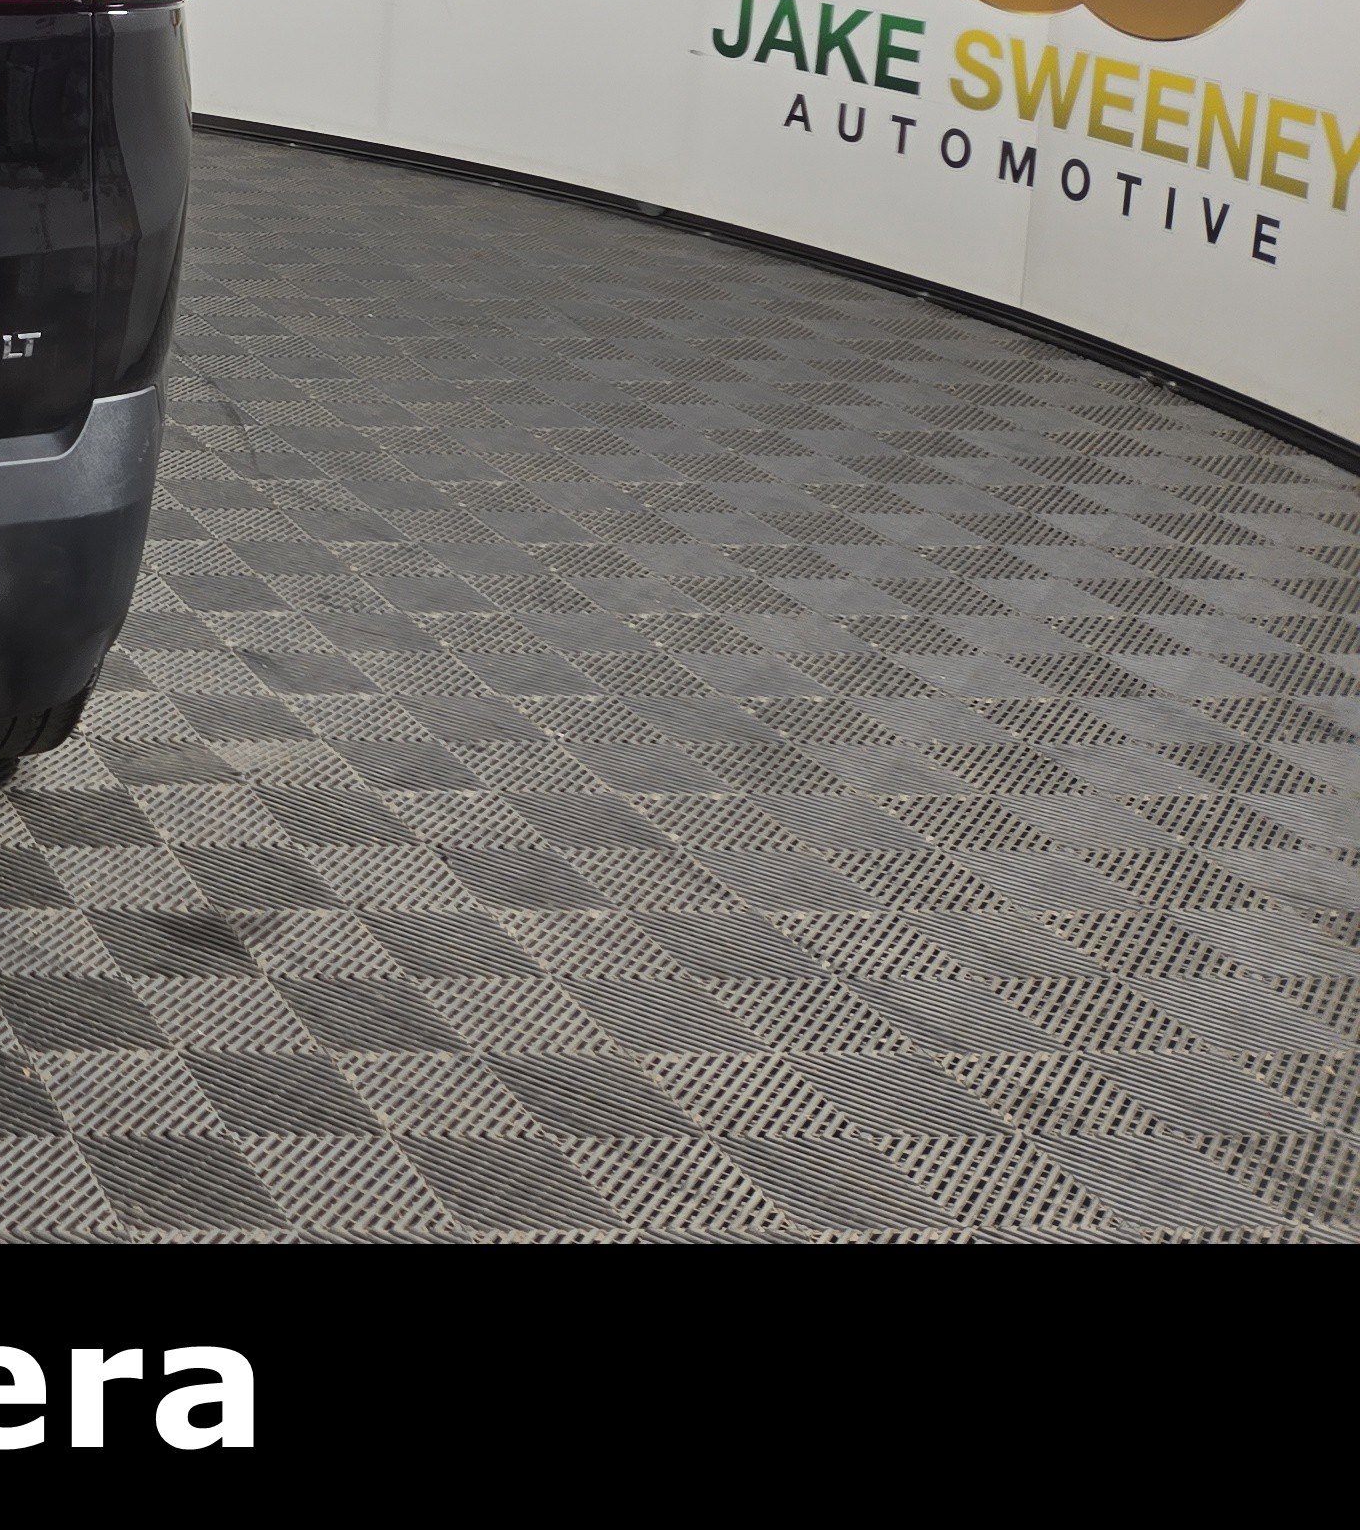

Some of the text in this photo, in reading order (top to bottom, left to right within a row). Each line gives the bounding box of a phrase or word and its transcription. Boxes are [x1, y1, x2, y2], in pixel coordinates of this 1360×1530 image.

[783, 93, 1281, 265] AUTOMOTIVE
[949, 29, 1360, 211] SWEENEY
[2, 331, 42, 359] LT
